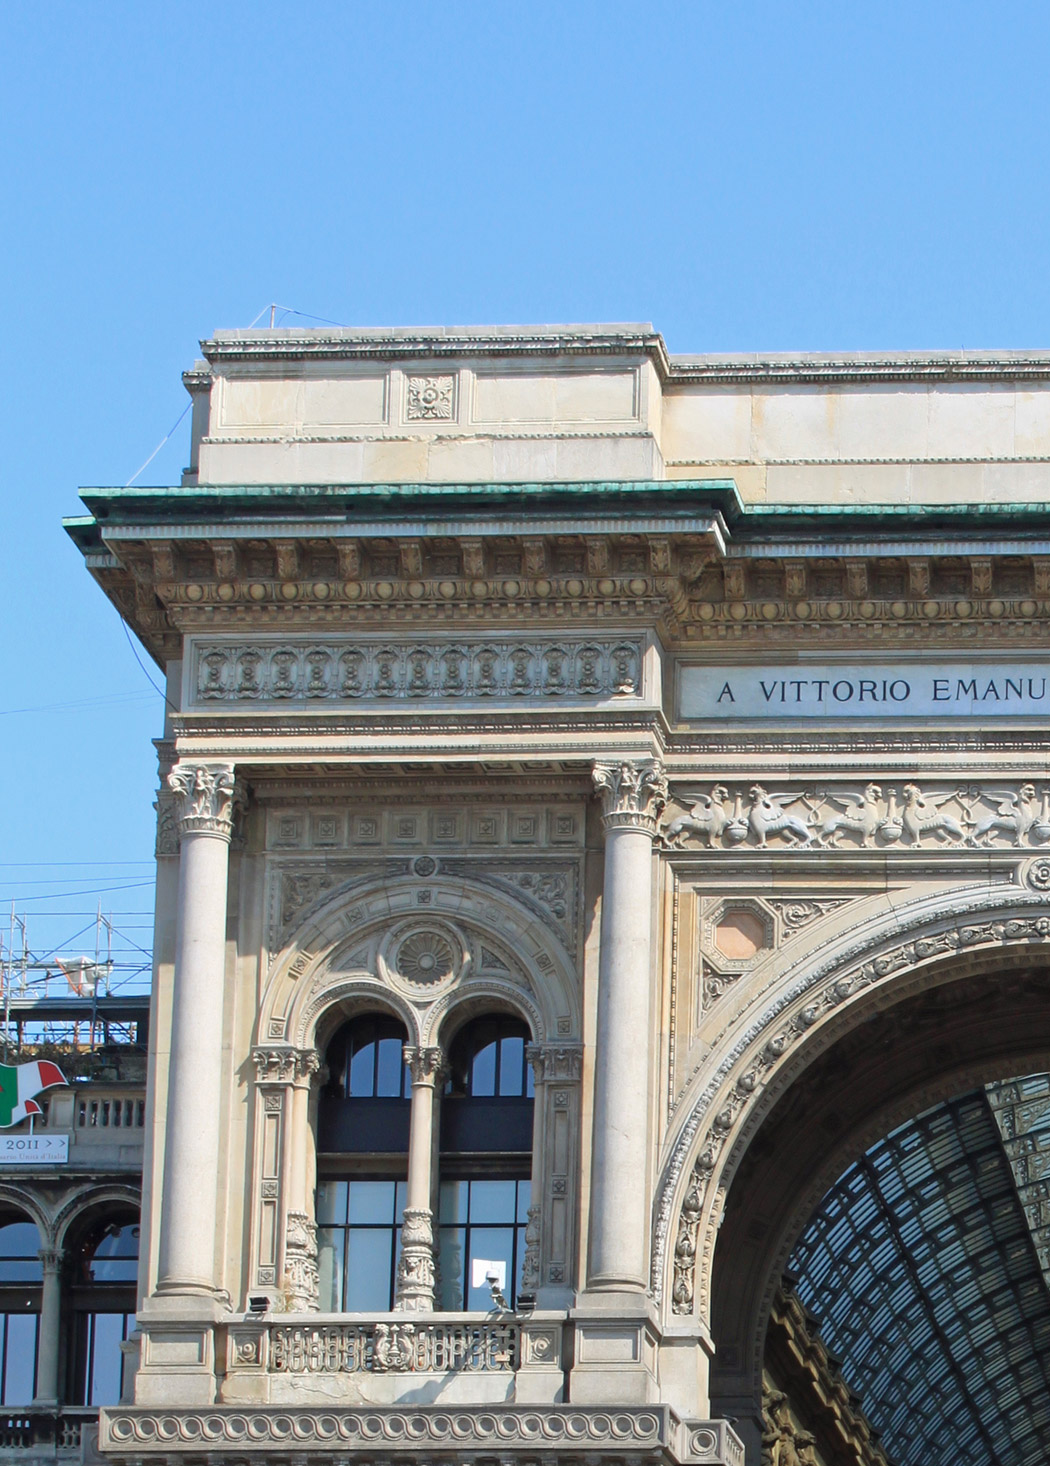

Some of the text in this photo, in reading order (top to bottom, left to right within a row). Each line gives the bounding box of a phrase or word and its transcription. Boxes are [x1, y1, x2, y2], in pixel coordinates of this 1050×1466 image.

[717, 681, 736, 702] A
[759, 680, 911, 702] VITTORIO
[6, 1140, 38, 1150] 2011
